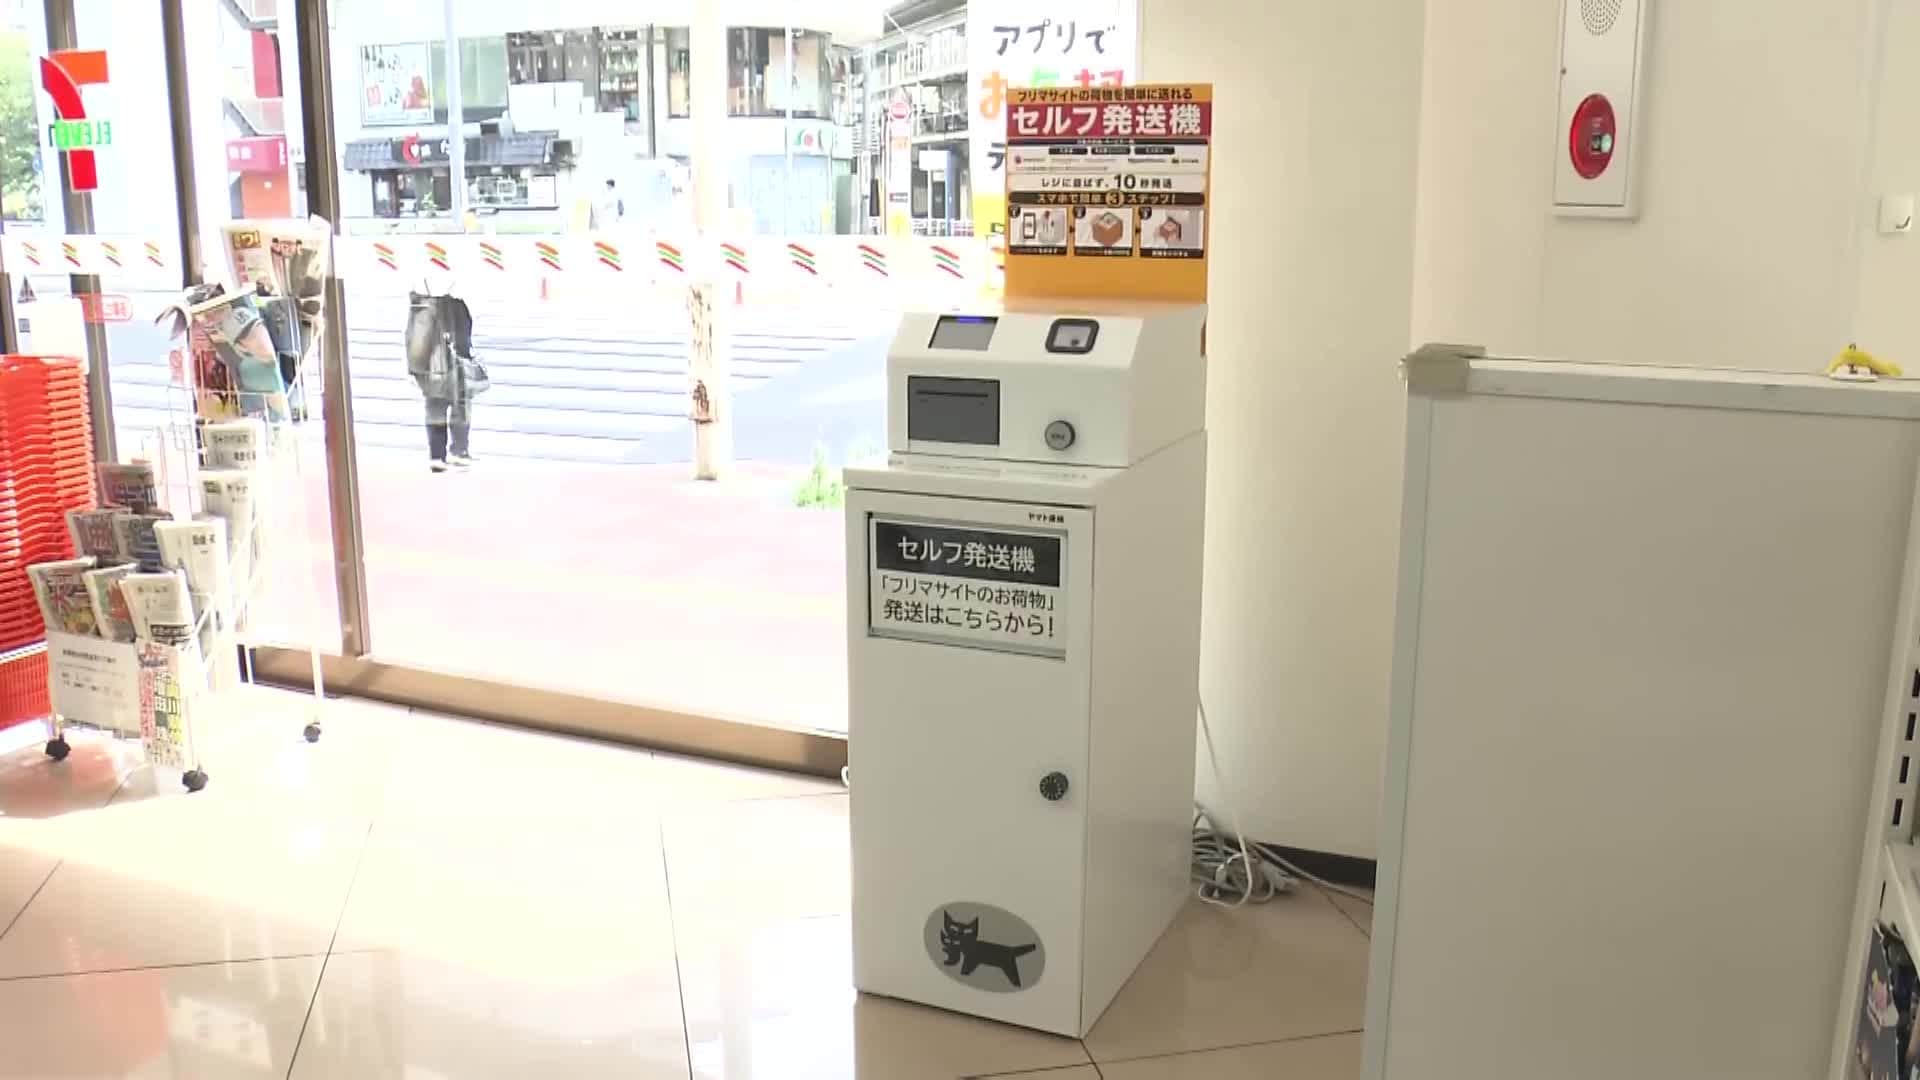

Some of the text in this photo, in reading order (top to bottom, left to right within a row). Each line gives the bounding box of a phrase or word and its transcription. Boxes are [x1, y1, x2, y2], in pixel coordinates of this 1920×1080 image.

[993, 18, 1116, 56] アプリで
[1017, 88, 1192, 103] フリマサイトの荷物を簡単に送れる
[1012, 103, 1201, 136] セルフ発送機
[897, 536, 1036, 573] セルフ発送機
[882, 575, 1054, 611] 「フリマサイトのお荷物」
[883, 598, 1054, 637] 発送はこちらから!
